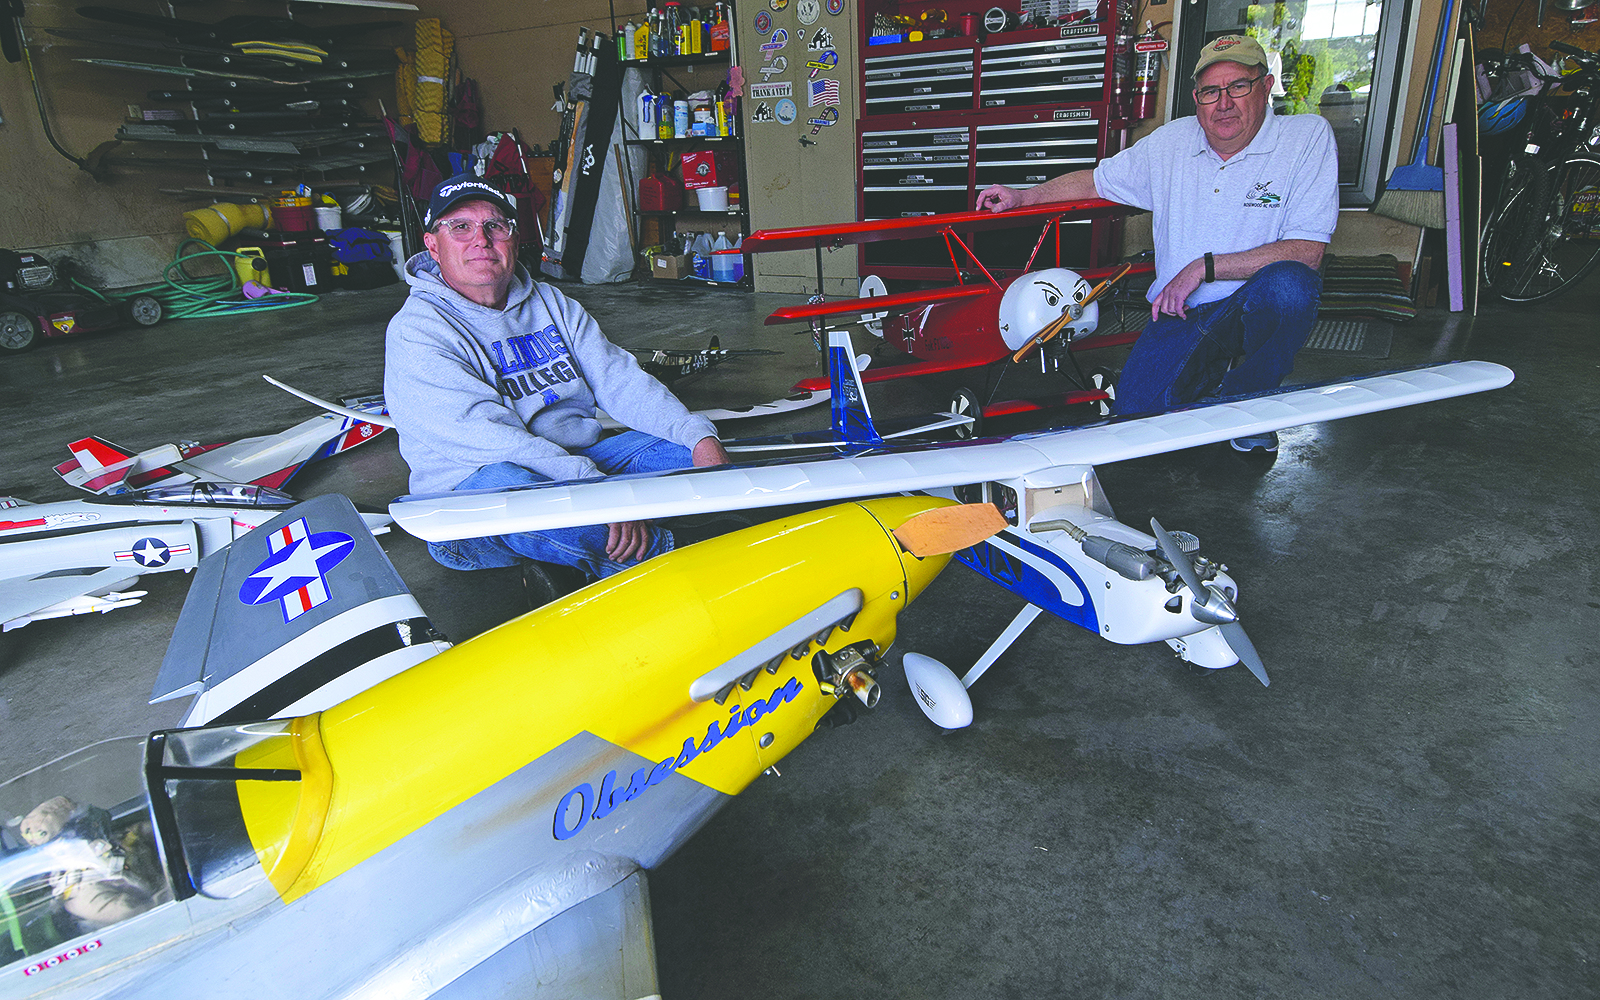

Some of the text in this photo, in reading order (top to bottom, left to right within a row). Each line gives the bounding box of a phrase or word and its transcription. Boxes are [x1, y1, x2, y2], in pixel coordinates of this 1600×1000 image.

[1063, 27, 1097, 36] CRAFTSMAN
[752, 89, 771, 97] THANK
[1056, 111, 1089, 119] CRAFTSMAN
[439, 181, 505, 198] TaylorMade
[552, 676, 804, 841] Obsession
